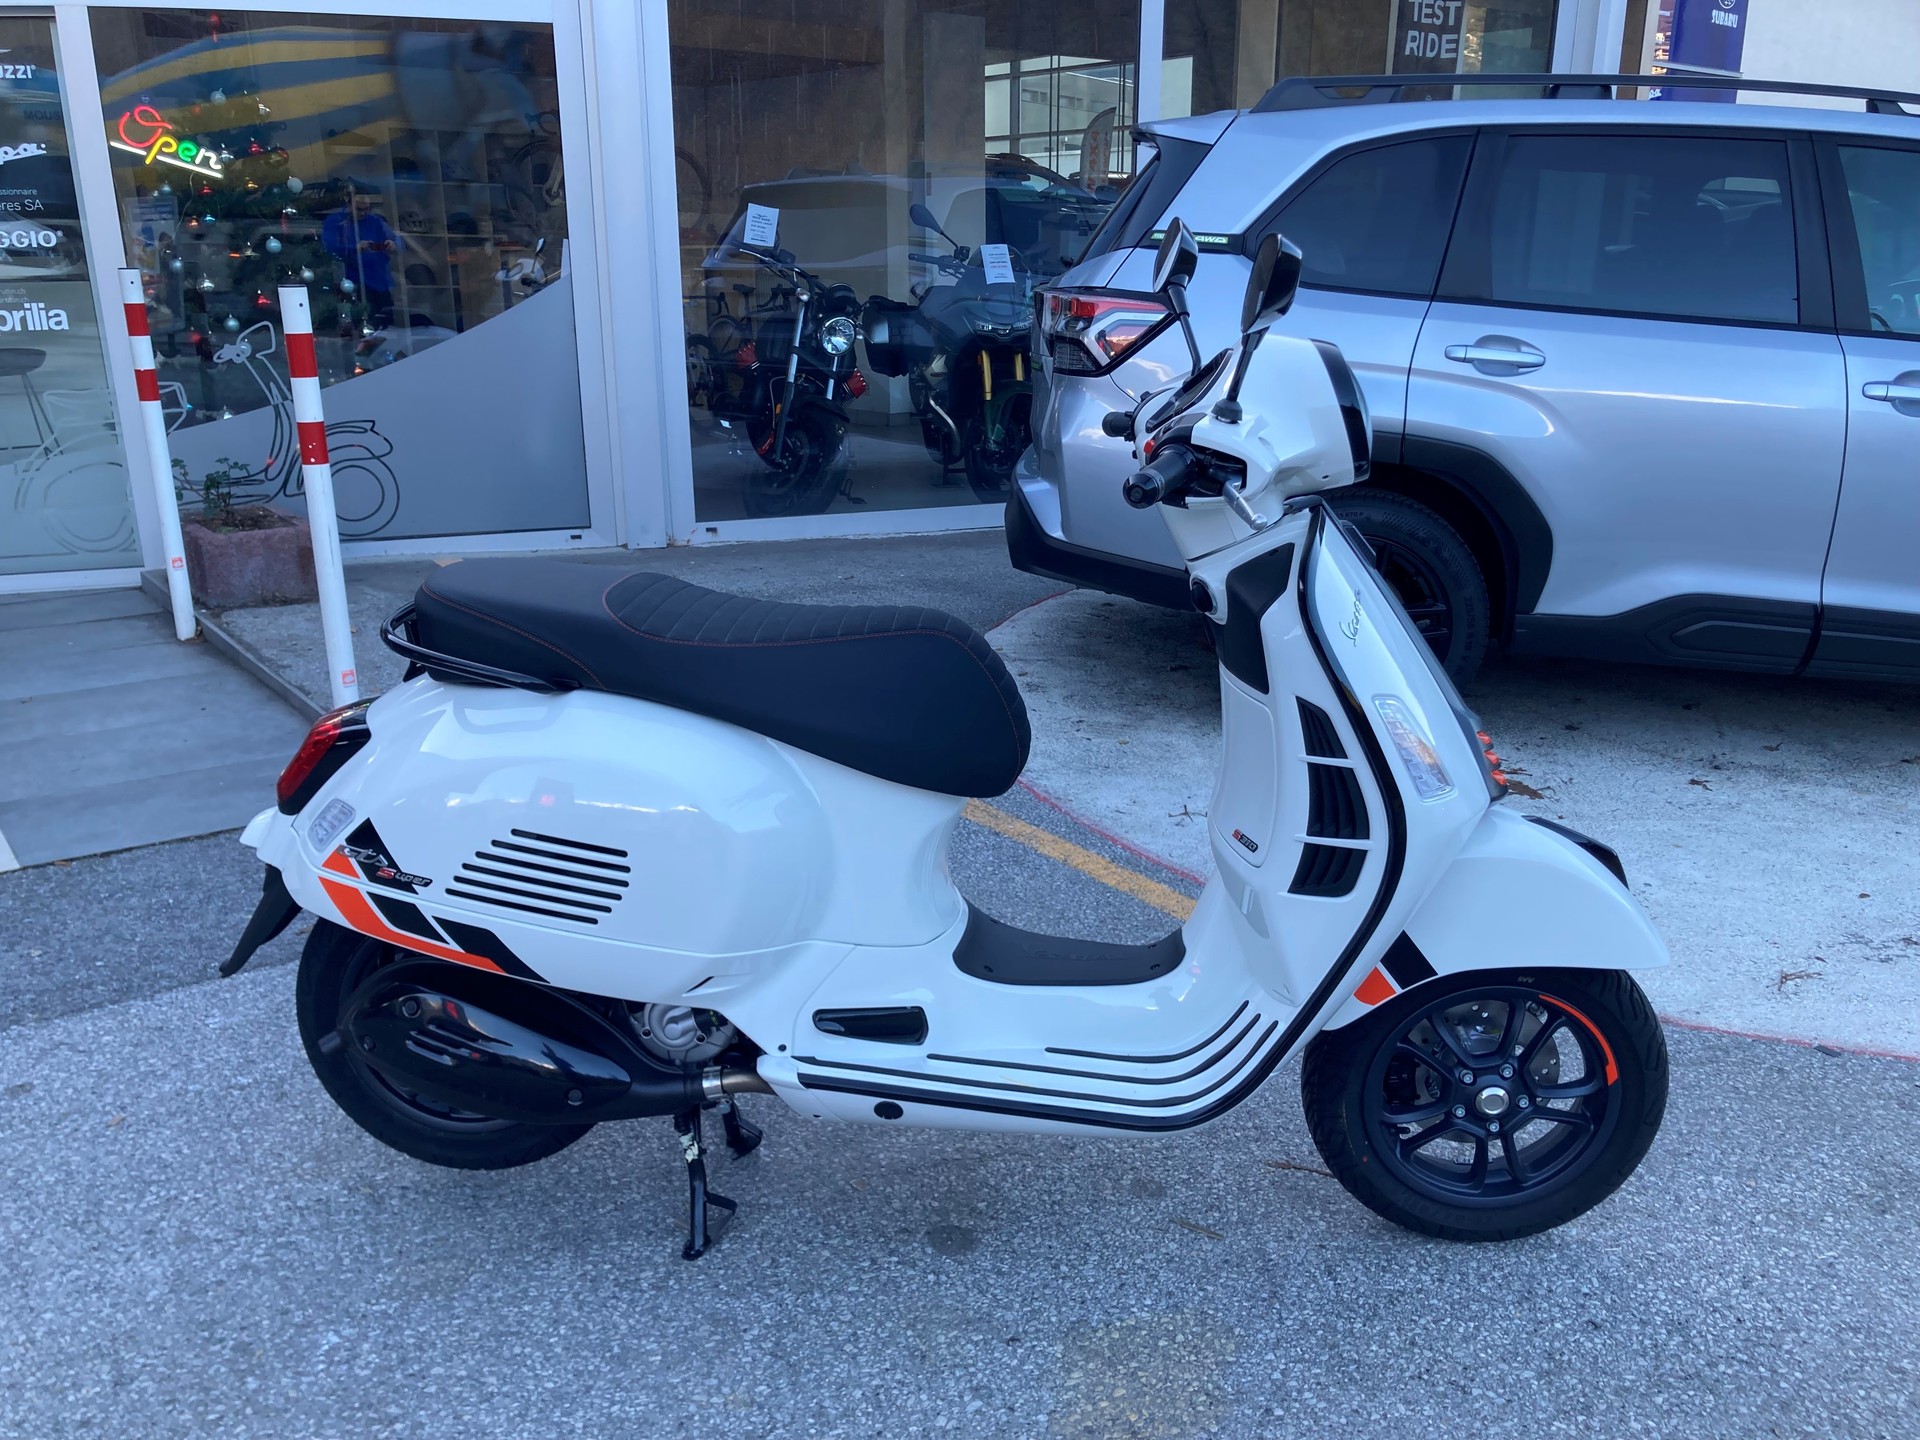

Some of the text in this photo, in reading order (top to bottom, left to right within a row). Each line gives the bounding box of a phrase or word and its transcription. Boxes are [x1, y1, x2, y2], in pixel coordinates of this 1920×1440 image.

[1409, 0, 1462, 26] TEST
[1711, 9, 1739, 28] SUBARU
[1404, 30, 1459, 59] RIDE
[118, 104, 222, 166] Open
[24, 199, 44, 211] SA
